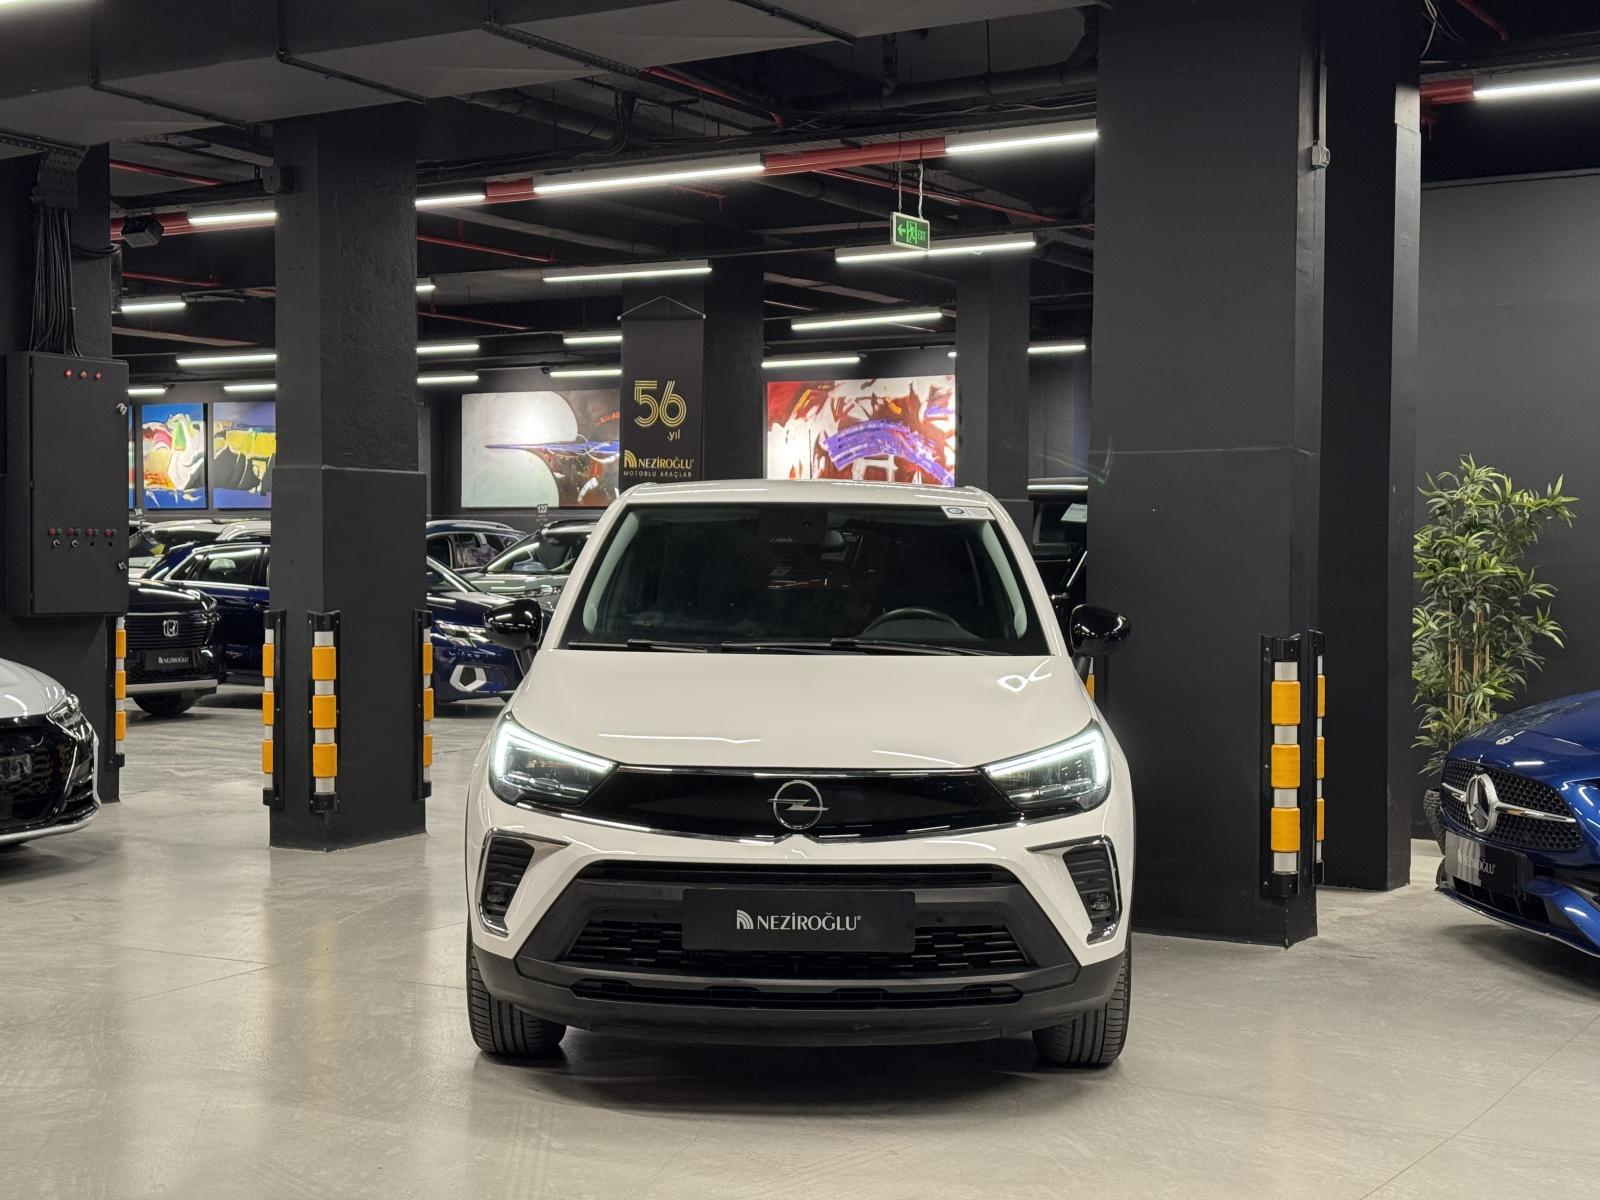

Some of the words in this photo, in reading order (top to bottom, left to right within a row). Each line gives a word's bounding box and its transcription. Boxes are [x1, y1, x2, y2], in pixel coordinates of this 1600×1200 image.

[634, 380, 687, 427] 56
[638, 456, 692, 469] NEZİROĞLU
[660, 470, 692, 478] ARAÇLAR
[757, 912, 857, 931] NEZİROĞLU
